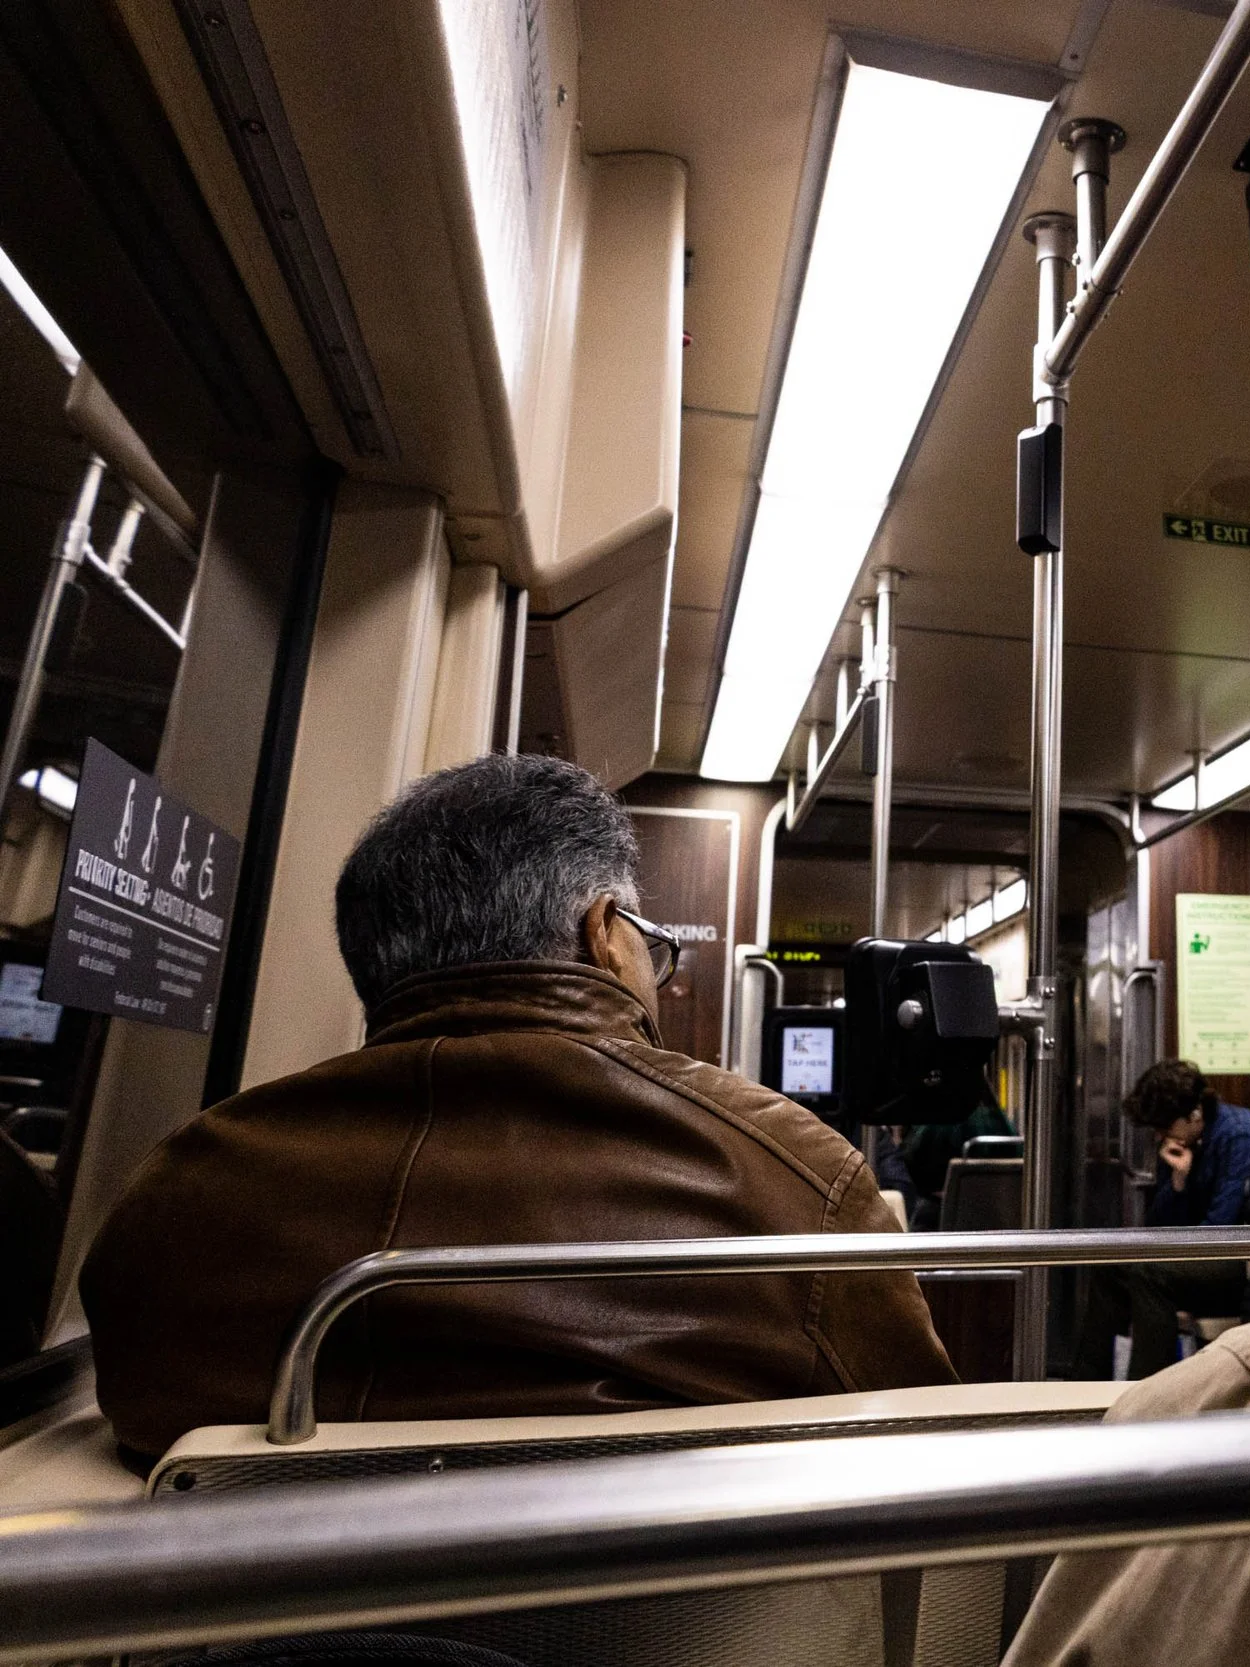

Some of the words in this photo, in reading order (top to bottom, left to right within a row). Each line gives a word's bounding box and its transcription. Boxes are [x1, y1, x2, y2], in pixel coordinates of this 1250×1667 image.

[1212, 524, 1249, 542] EXIT
[75, 849, 117, 891] PRIORITY
[115, 868, 149, 906] SEATING
